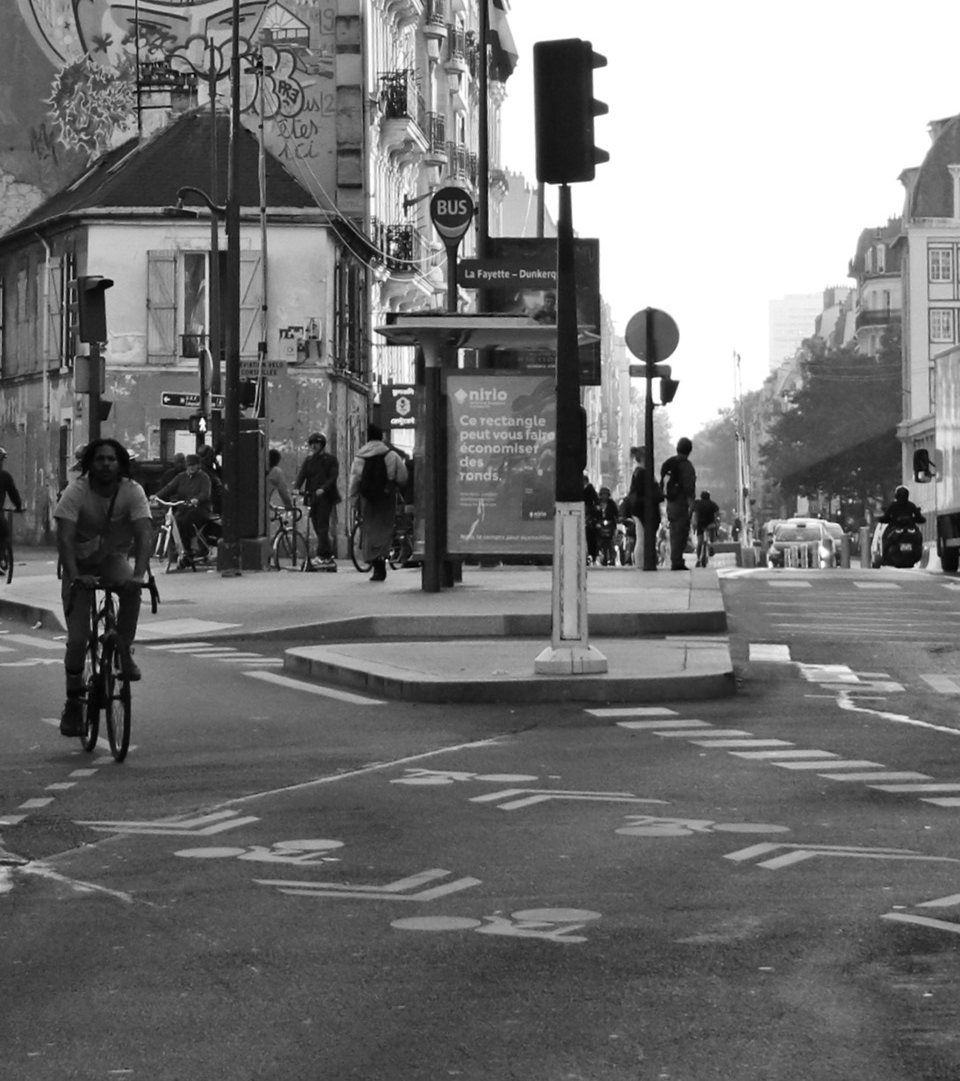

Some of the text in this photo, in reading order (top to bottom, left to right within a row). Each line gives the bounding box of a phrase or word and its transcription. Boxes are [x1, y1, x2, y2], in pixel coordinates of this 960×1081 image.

[277, 118, 318, 139] êtes
[437, 199, 467, 215] BUS
[464, 269, 475, 279] La
[477, 269, 510, 280] Fayette
[519, 269, 557, 280] Dunkerq
[469, 387, 508, 401] nirio
[460, 415, 546, 428] Ce rectangle
[460, 428, 555, 441] peut vous faire
[460, 442, 540, 454] économiser
[459, 455, 484, 467] des
[459, 469, 502, 481] ronds.
